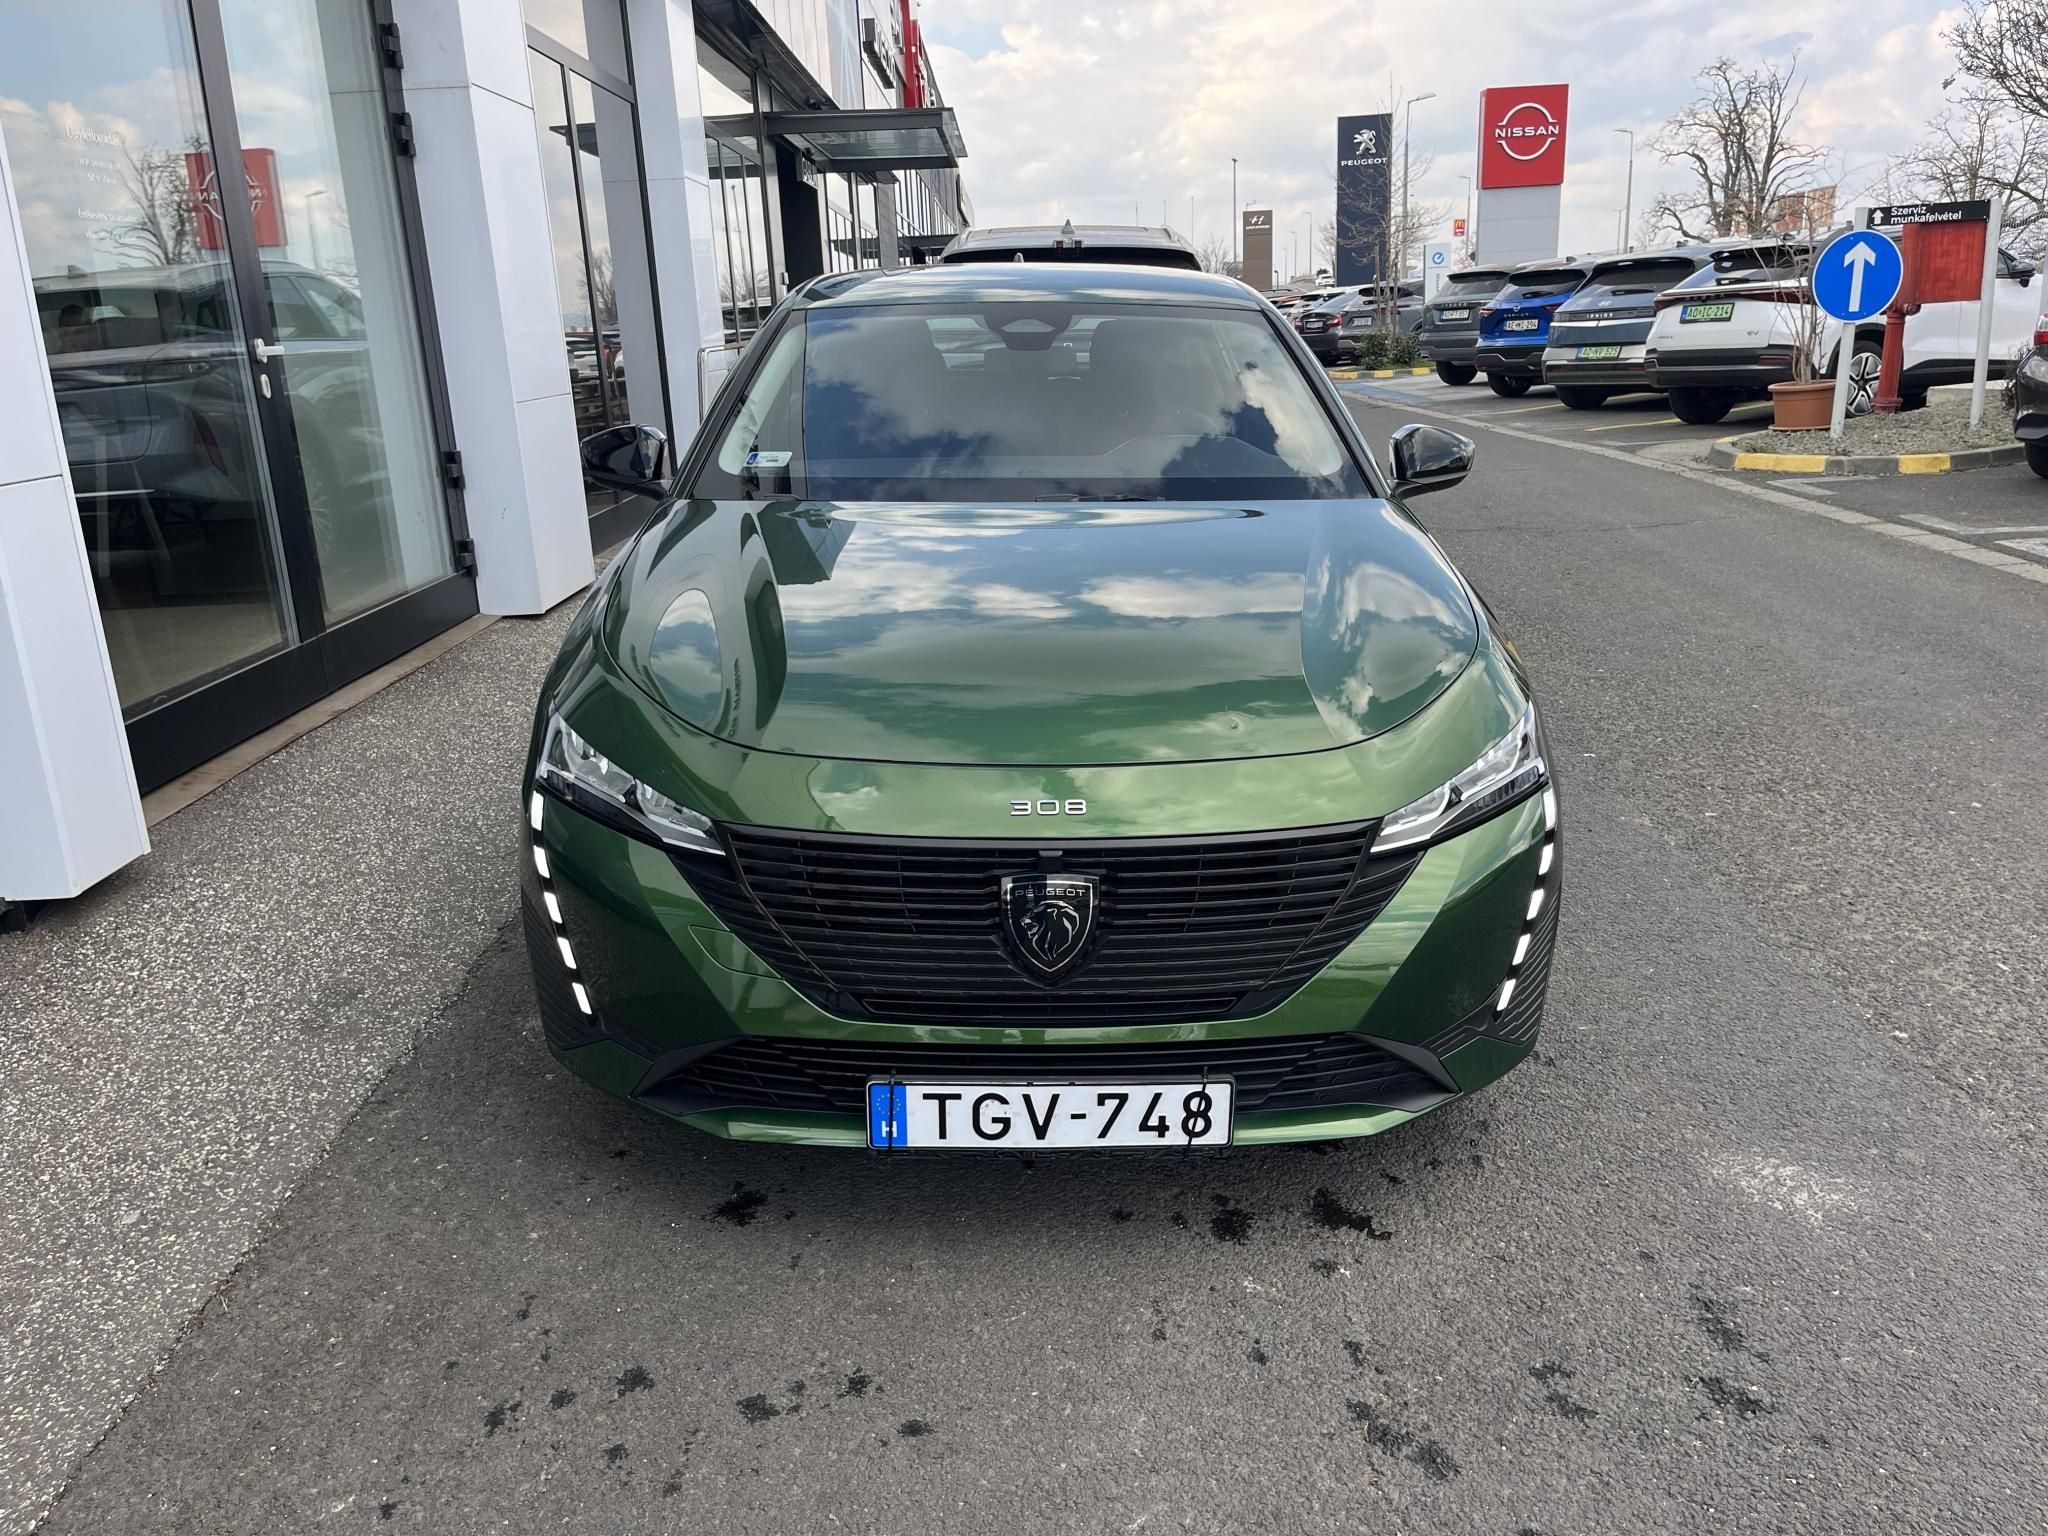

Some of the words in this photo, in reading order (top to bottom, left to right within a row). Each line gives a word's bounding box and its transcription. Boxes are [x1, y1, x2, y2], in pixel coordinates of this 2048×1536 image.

[1495, 125, 1559, 138] NISSAN
[1341, 157, 1388, 166] PEUGEOT
[1890, 210, 1962, 225] munkafelvétel
[1010, 799, 1087, 816] 308
[1015, 888, 1086, 897] PEUGEOT
[881, 1120, 898, 1138] H
[922, 1090, 1213, 1141] TGV-748
